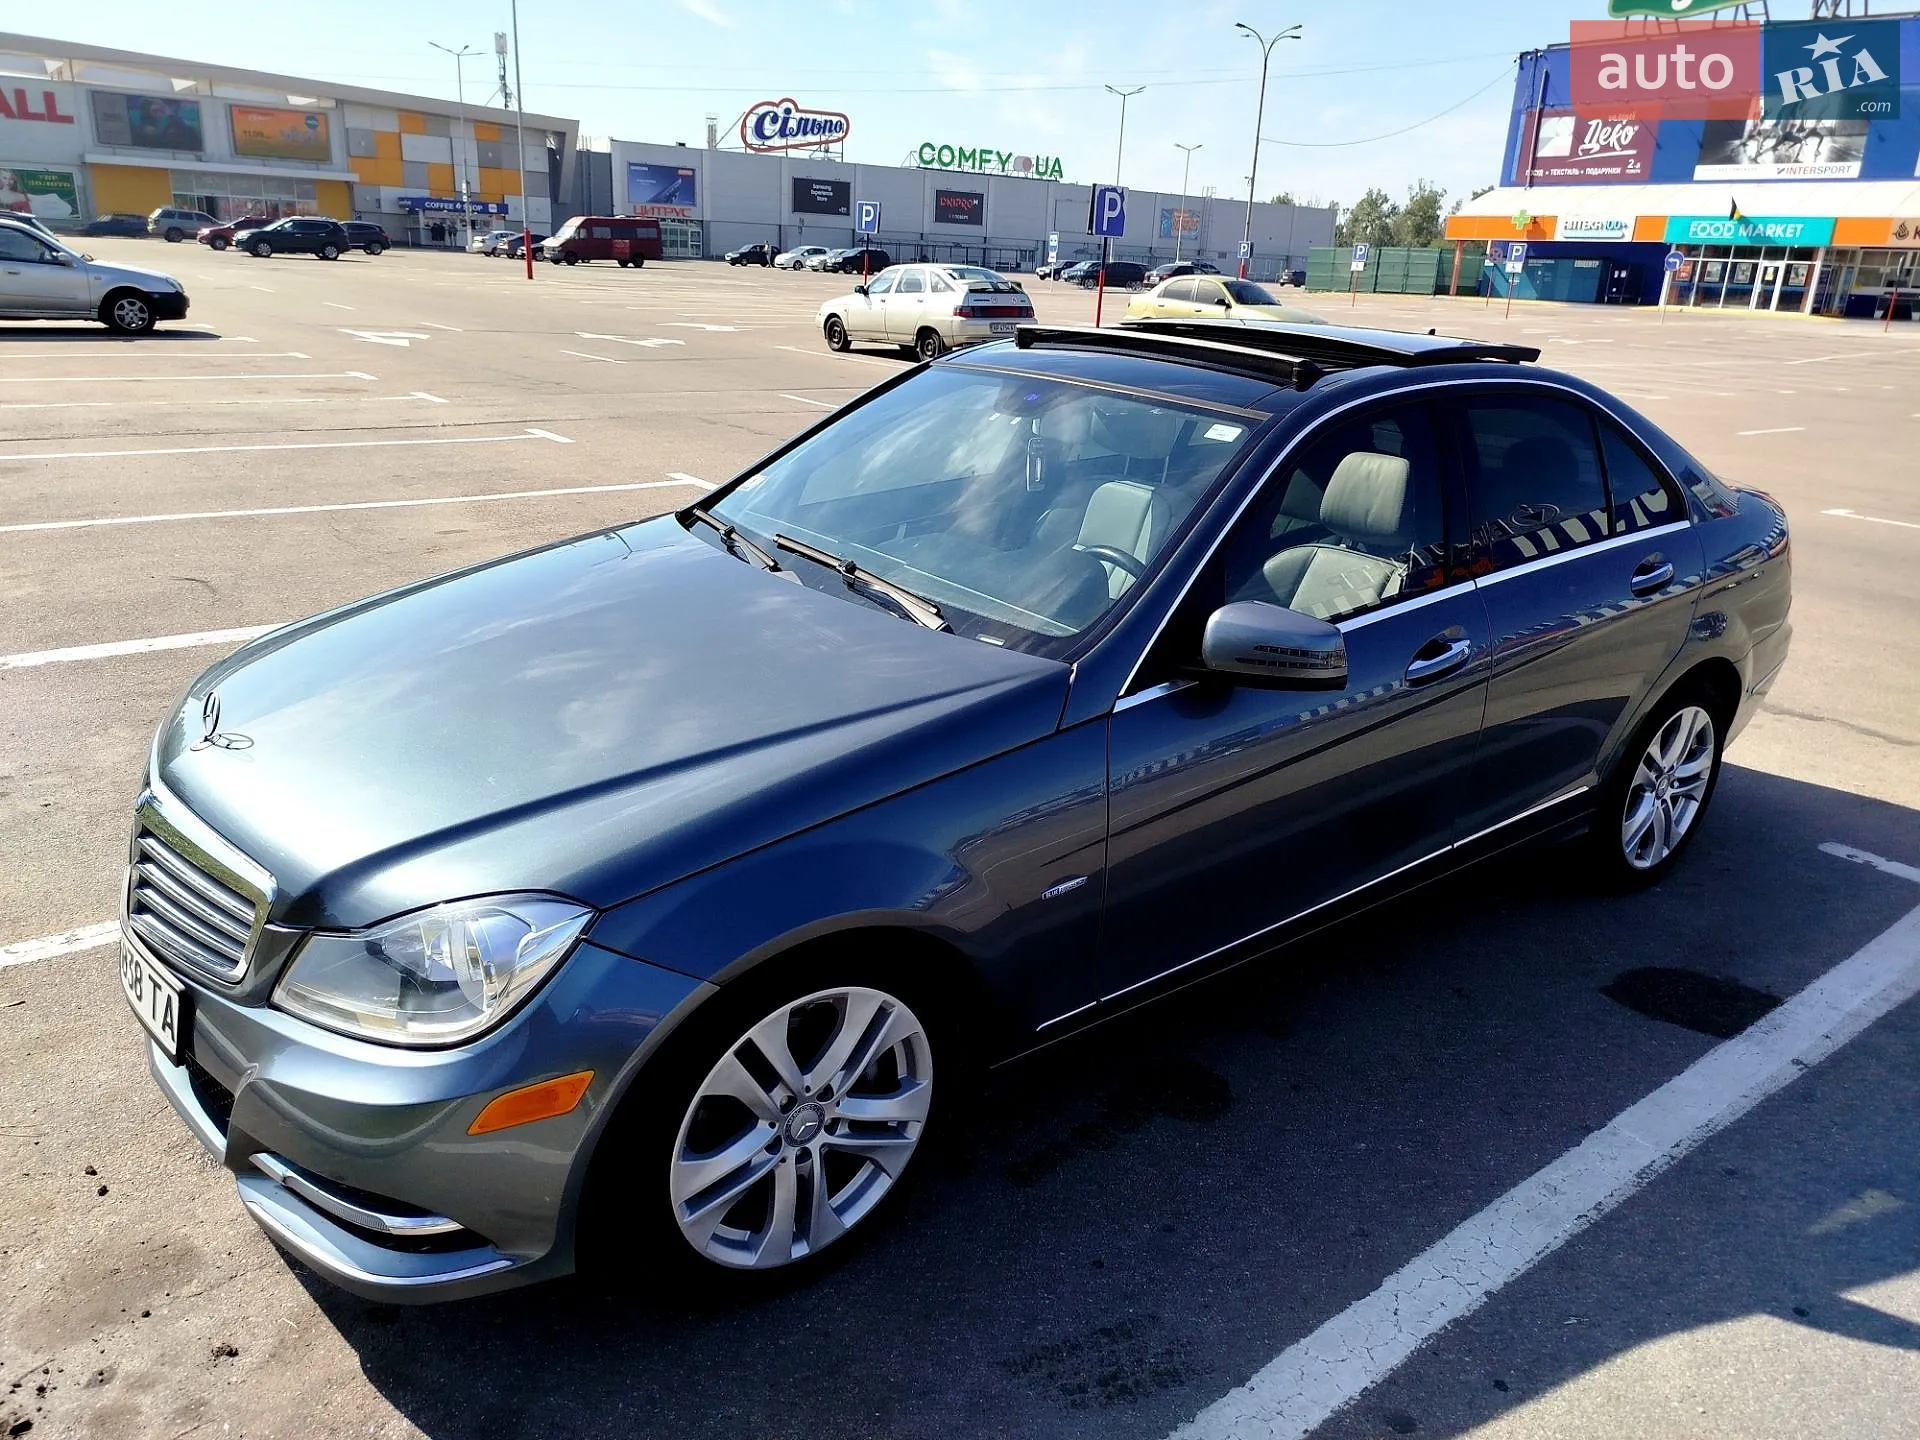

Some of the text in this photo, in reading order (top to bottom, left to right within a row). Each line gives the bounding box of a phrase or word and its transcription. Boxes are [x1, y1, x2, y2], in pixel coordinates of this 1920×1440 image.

[754, 107, 843, 140] Сільпо
[919, 142, 1012, 173] COMFY
[1550, 168, 1580, 177] ТЕКСТИЛЬ
[1585, 167, 1621, 176] ПОДАРУНКИ
[1786, 165, 1852, 175] INTERSPORT
[425, 201, 454, 210] COFFEE
[1103, 191, 1121, 231] P
[862, 205, 874, 230] P
[1689, 221, 1804, 238] FOOD MARKET
